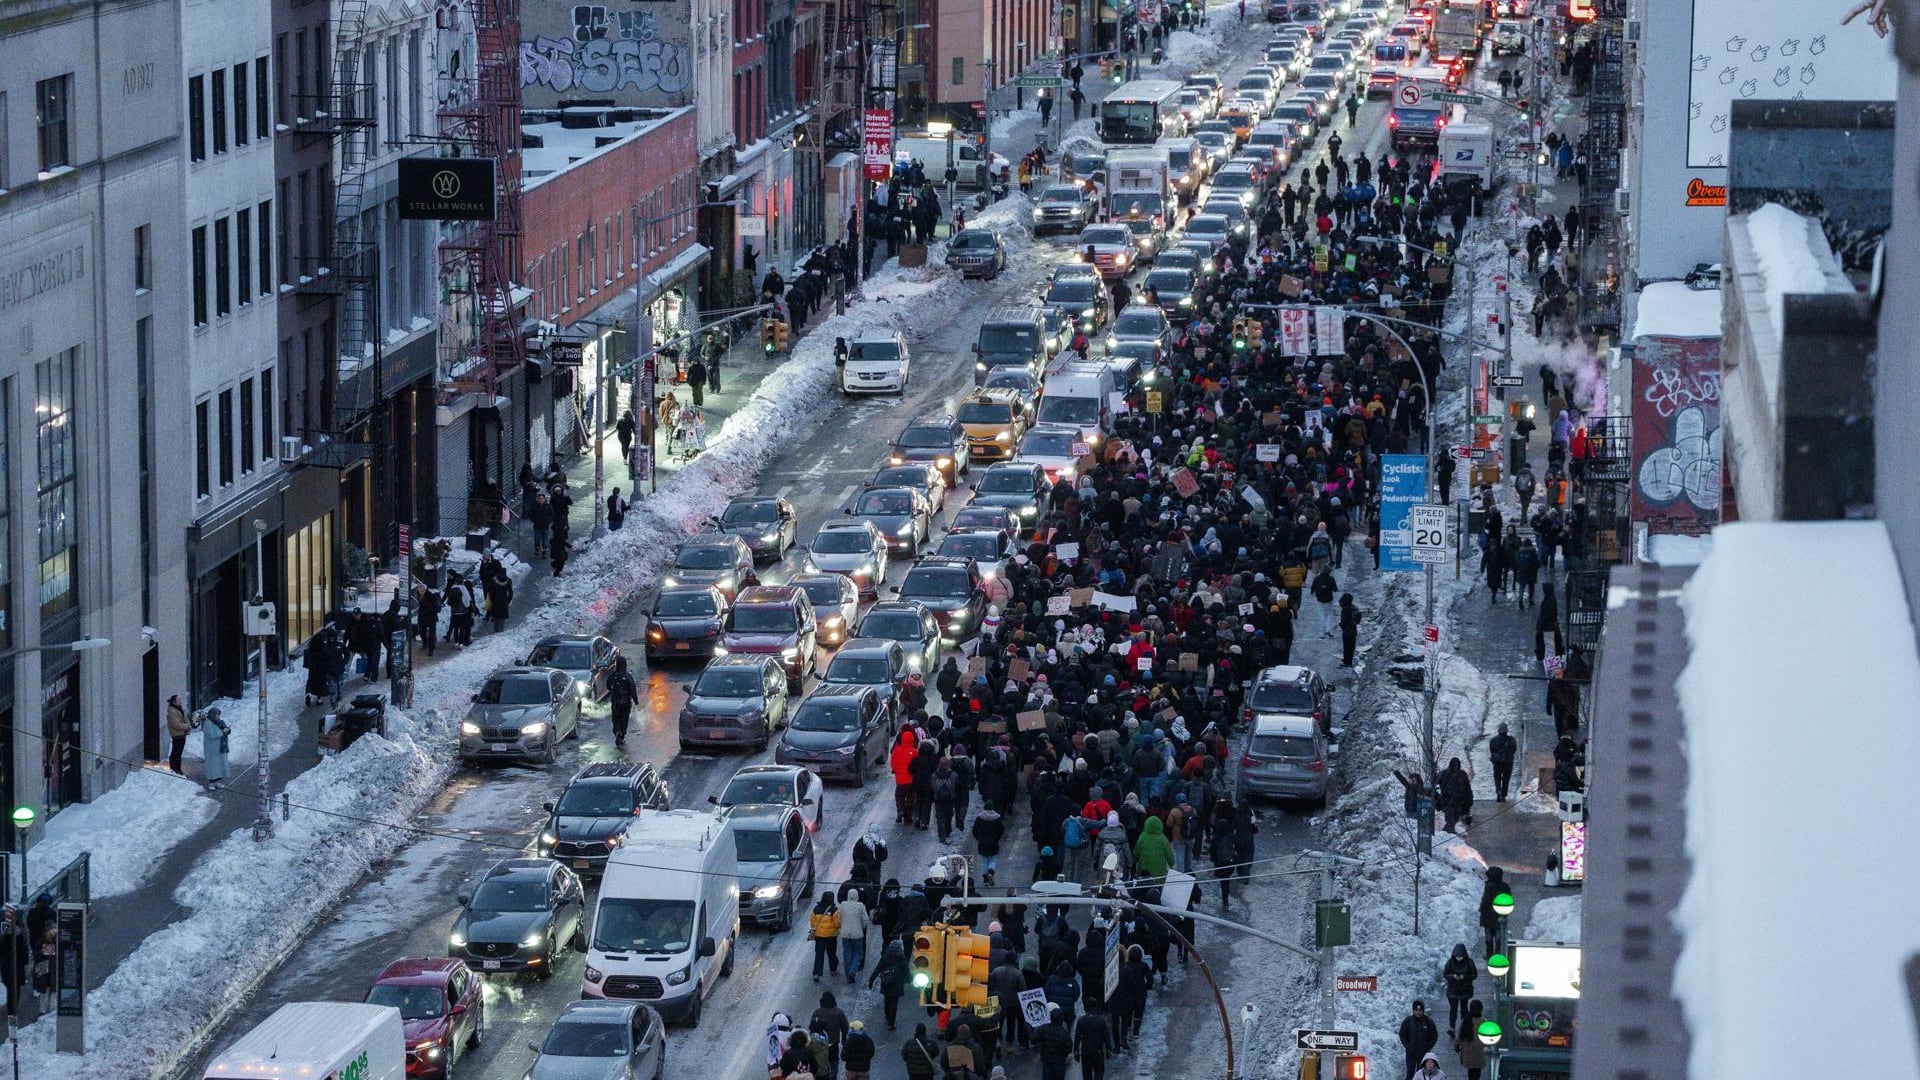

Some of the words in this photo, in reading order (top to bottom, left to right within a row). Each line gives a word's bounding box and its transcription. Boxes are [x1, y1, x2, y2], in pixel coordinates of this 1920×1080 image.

[409, 202, 449, 210] STELLAR
[452, 202, 485, 211] WORKS
[1383, 463, 1424, 474] Cyclists:
[1383, 475, 1400, 483] Look
[1415, 508, 1444, 517] SPEED
[1418, 518, 1441, 527] LIMIT
[1416, 529, 1442, 546] 20
[1337, 979, 1372, 991] Broadway
[1307, 1035, 1324, 1044] ONE
[1335, 1036, 1352, 1045] WAY
